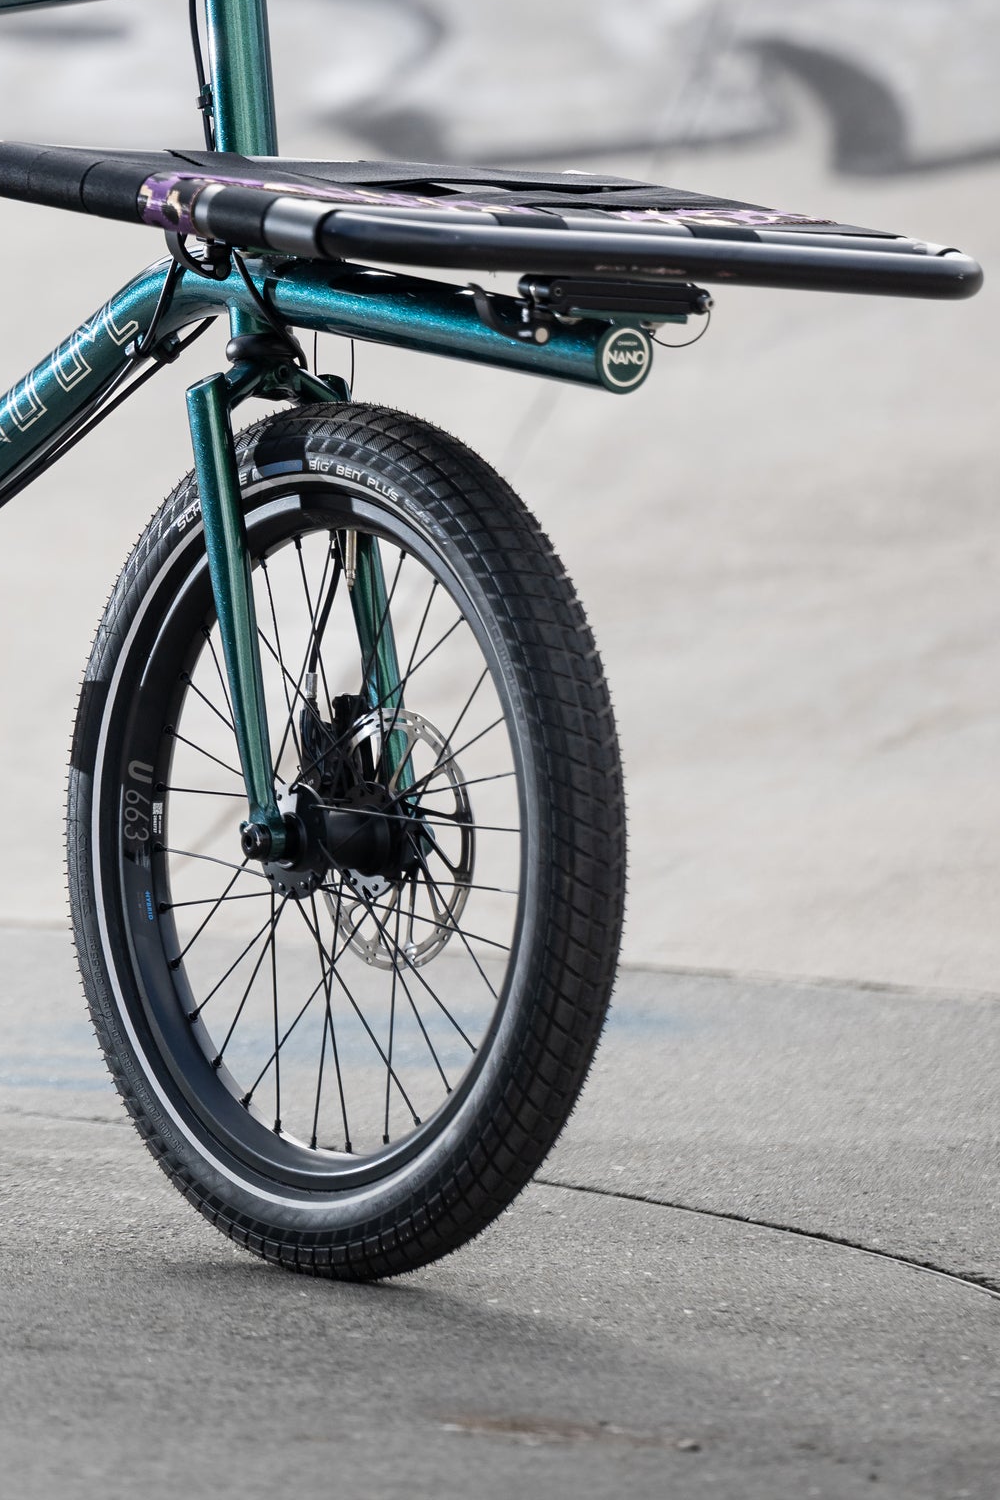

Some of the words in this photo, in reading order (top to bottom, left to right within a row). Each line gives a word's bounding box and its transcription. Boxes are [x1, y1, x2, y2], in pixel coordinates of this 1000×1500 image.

[607, 349, 645, 365] NANO
[309, 458, 331, 473] BIG
[336, 465, 364, 482] BEN
[367, 475, 400, 503] PLUS
[128, 760, 154, 784] U
[124, 789, 150, 841] 663
